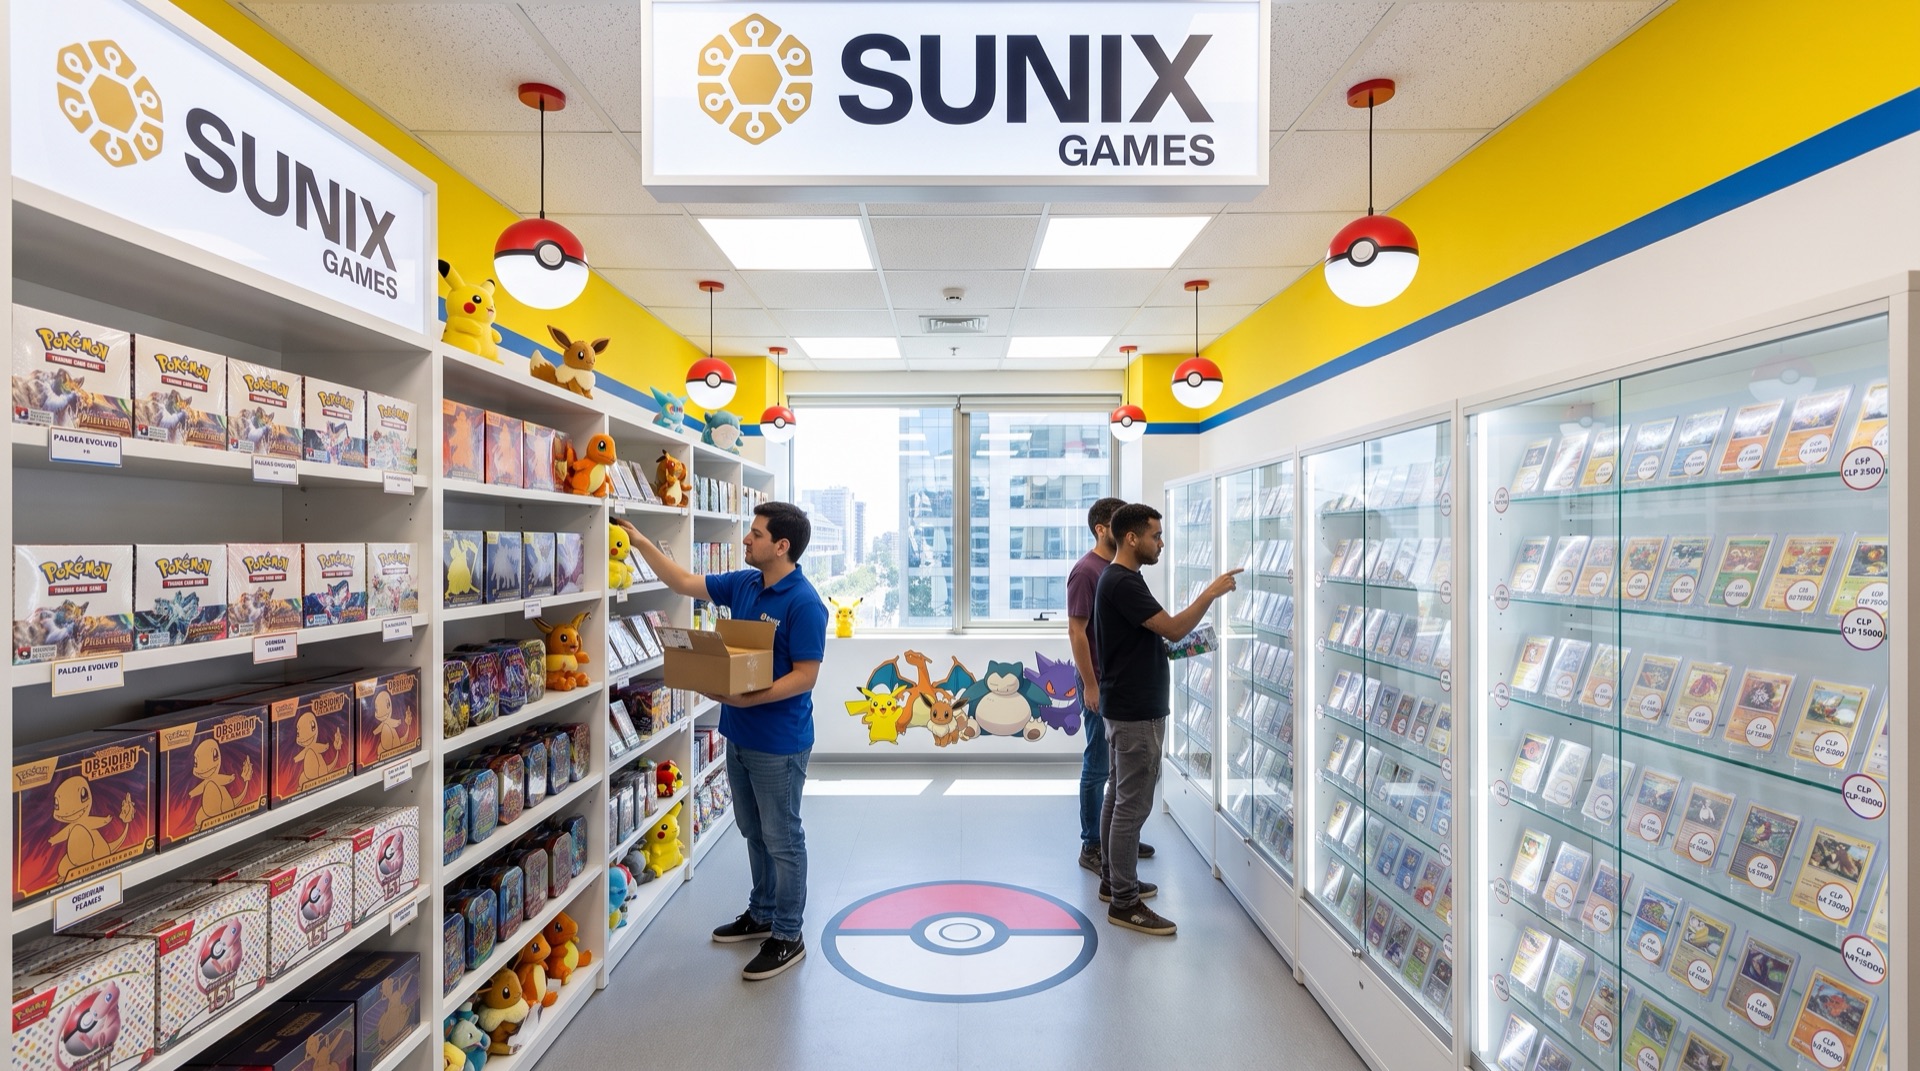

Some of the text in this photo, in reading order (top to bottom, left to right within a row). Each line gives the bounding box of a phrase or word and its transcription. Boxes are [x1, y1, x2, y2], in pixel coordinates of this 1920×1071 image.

[838, 33, 1214, 125] SUNIX
[1058, 134, 1215, 166] GAMES
[184, 107, 397, 273] SUNIX
[322, 249, 398, 300] GAMES
[53, 434, 118, 448] PALDEA EVOLVED
[1844, 469, 1858, 477] CLP
[1857, 617, 1871, 625] CLP
[1844, 626, 1882, 638] CLP 15000
[58, 661, 118, 675] PALDEA EVOLVED
[84, 747, 137, 774] OBSIDIAN
[91, 761, 132, 779] FLAMES
[1857, 784, 1872, 794] CLP
[1829, 890, 1843, 900] CLP
[306, 921, 328, 951] 151
[1857, 946, 1872, 958] CLP
[207, 977, 236, 1014] 151
[1822, 1037, 1836, 1047] CLP
